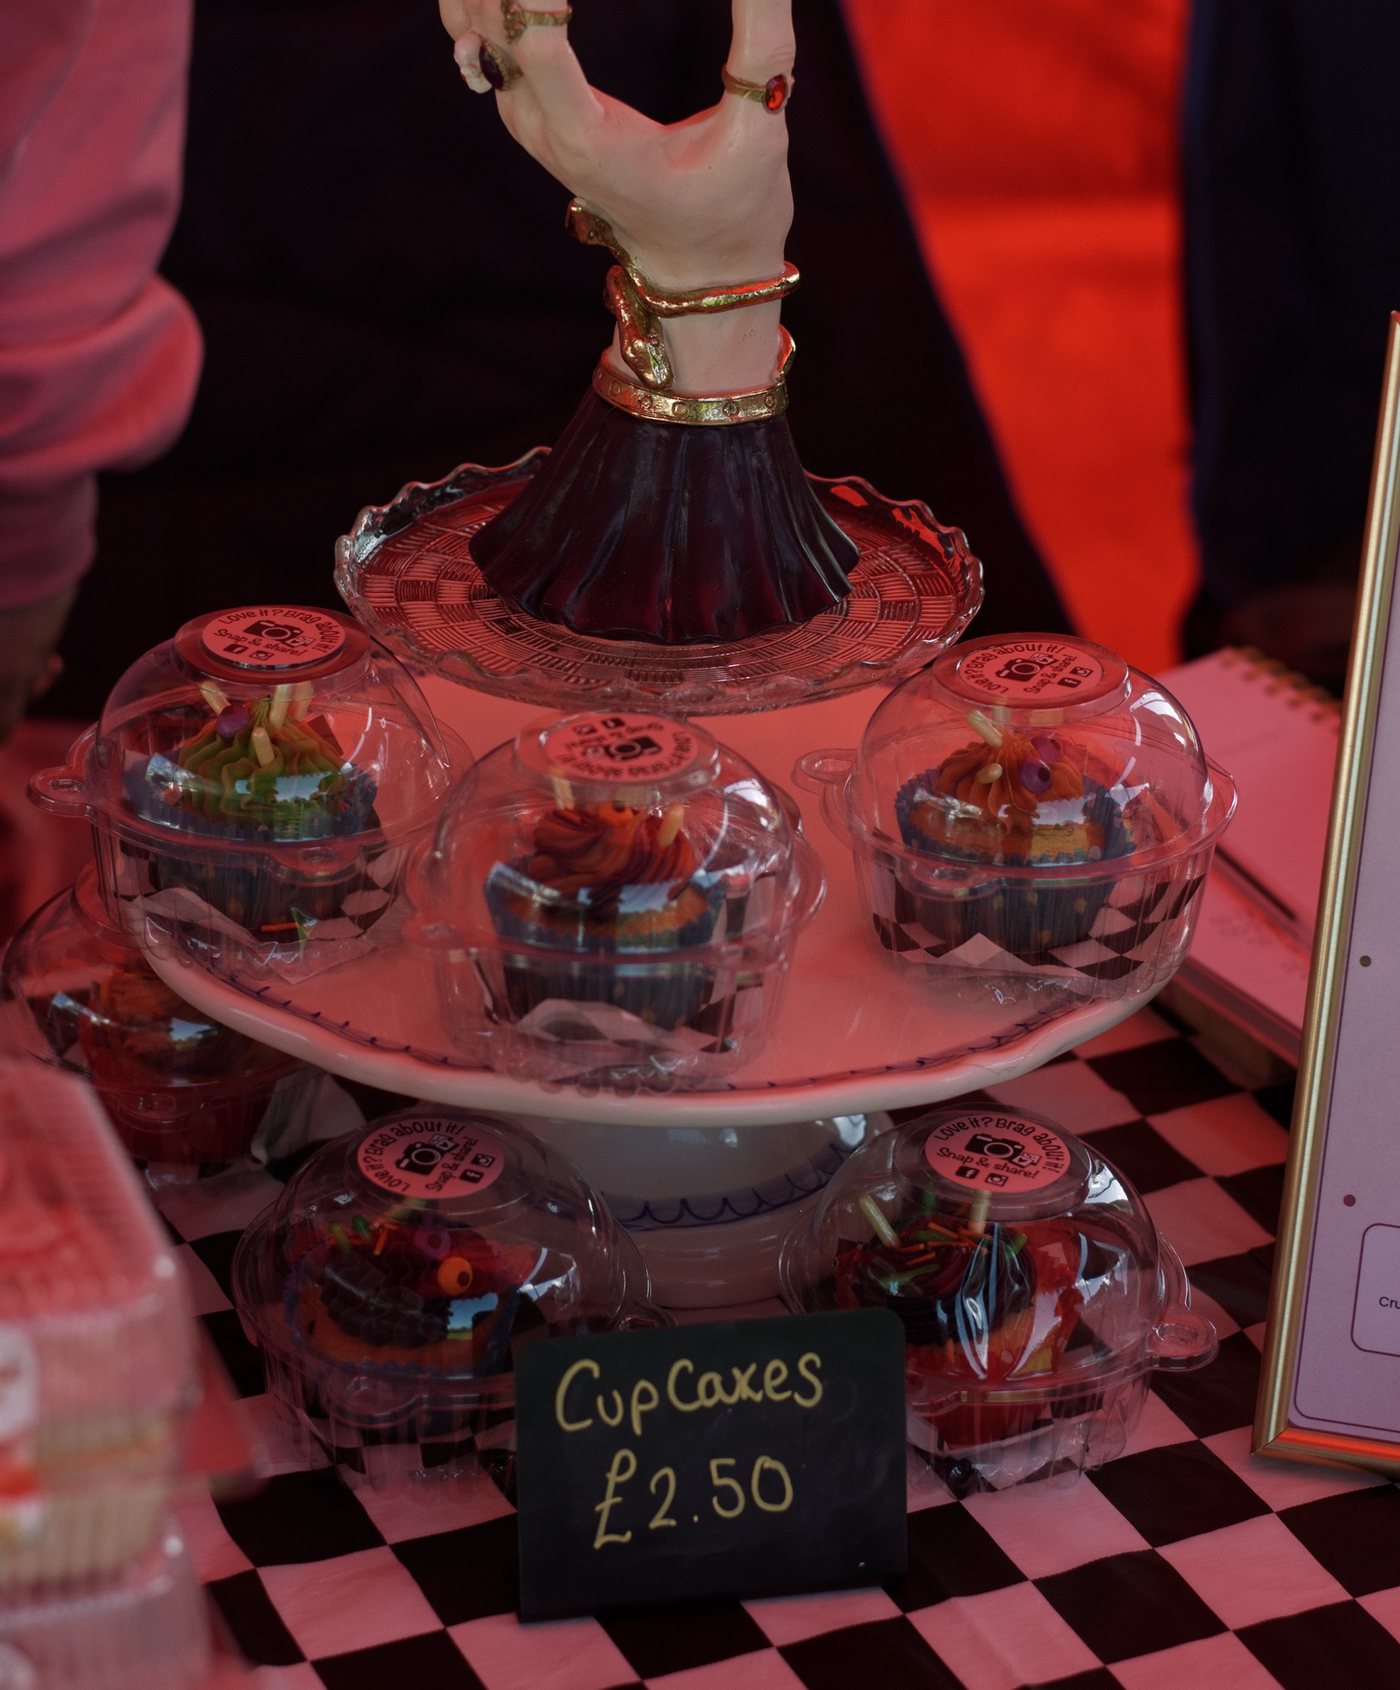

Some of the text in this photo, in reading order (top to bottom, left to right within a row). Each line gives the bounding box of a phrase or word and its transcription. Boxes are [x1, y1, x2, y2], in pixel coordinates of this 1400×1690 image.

[391, 1121, 442, 1136] about
[934, 1122, 970, 1140] Love
[995, 1118, 1036, 1136] Brag
[1033, 1132, 1065, 1161] about
[365, 1134, 397, 1156] Brag
[936, 1146, 974, 1165] Snap
[992, 1160, 1040, 1179] share!
[374, 1170, 410, 1192] Love
[593, 1448, 794, 1550] £2.50
